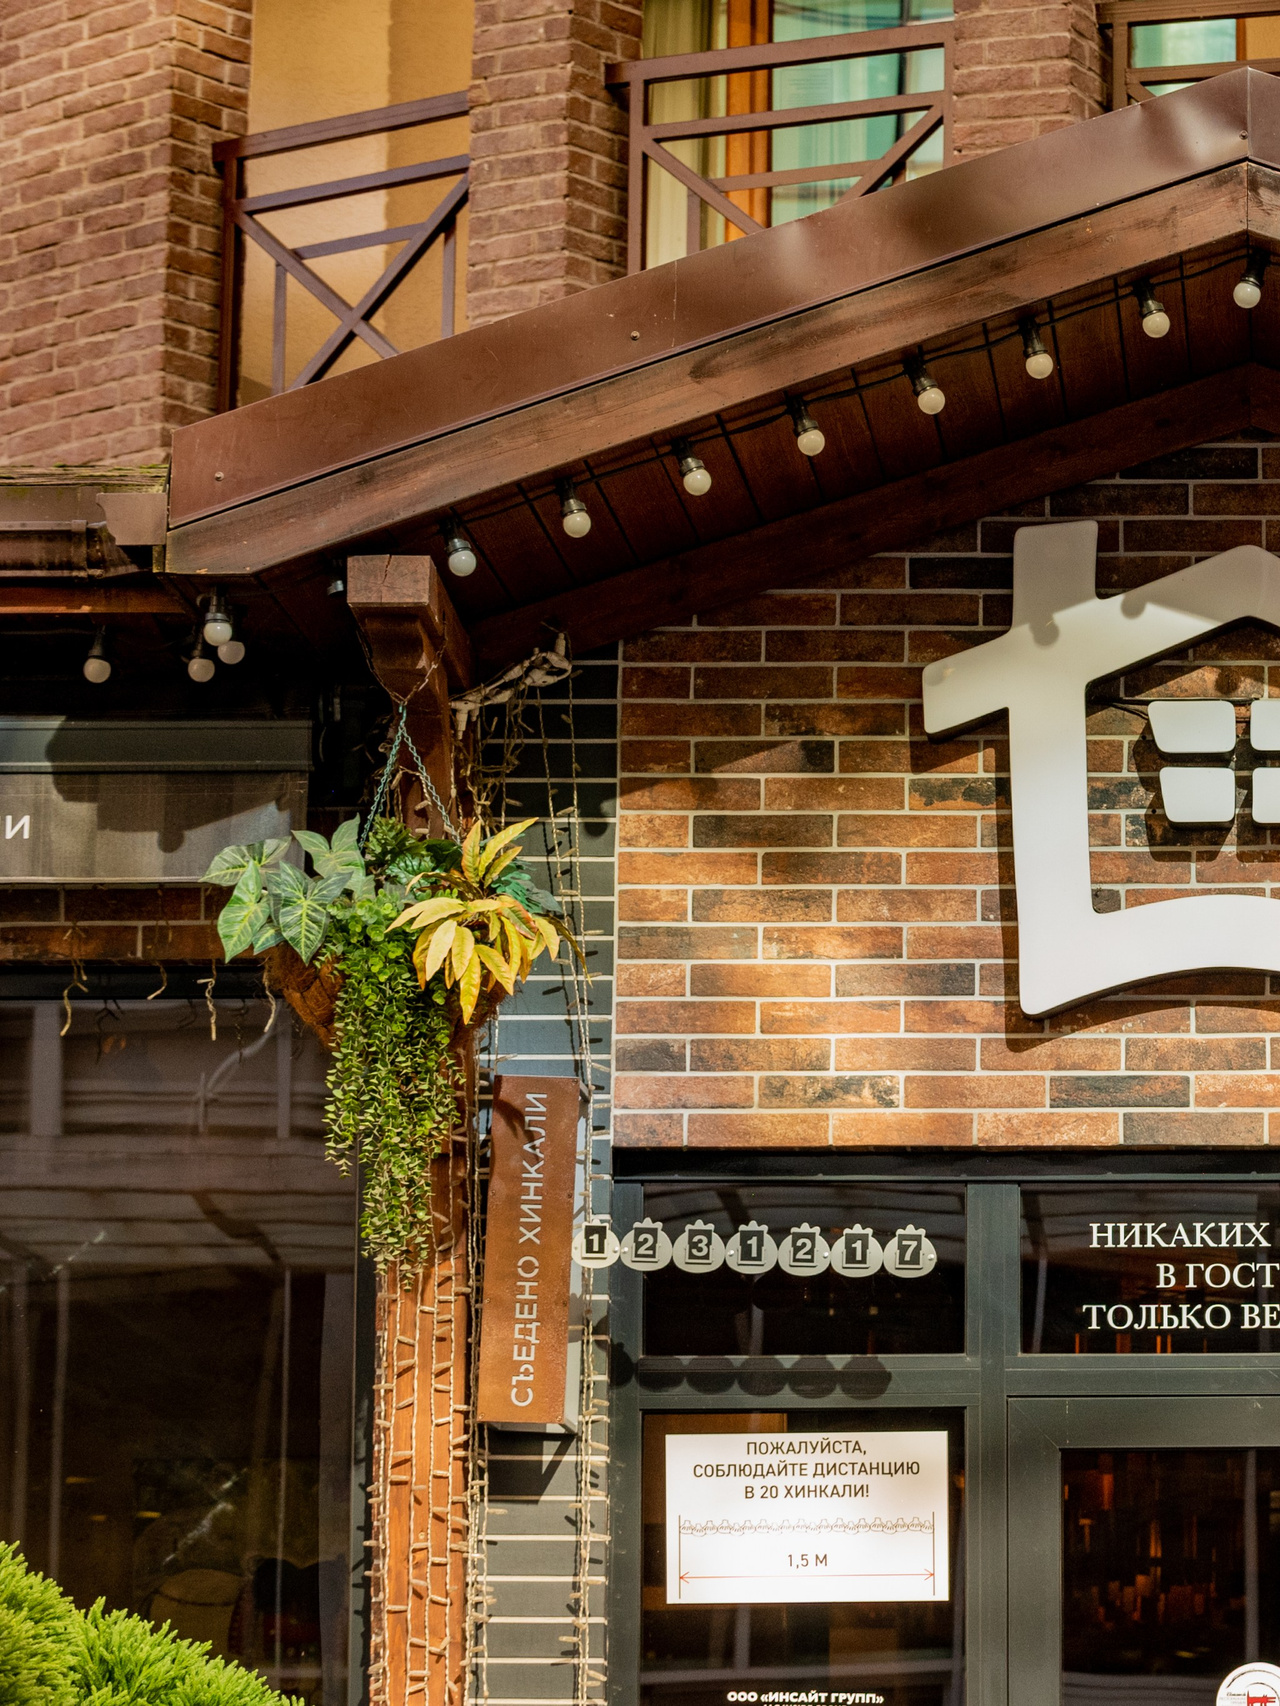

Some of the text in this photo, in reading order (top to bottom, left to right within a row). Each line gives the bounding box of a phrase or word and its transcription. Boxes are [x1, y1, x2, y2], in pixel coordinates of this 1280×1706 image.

[1089, 1222, 1271, 1248] НИКАКИХ
[511, 1093, 548, 1407] СЪЕДЕНО ХИНКАЛИ
[1156, 1263, 1176, 1288] В
[1083, 1304, 1231, 1330] ТОЛЬКО
[746, 1437, 867, 1456] ПОЖАЛУЙСТА,
[693, 1460, 920, 1479] СОБЛЮДАЙТЕ ДИСТАНЦИЮ
[744, 1484, 870, 1499] В 20 ХИНКАЛИ!
[787, 1554, 828, 1568] 1,5 М
[727, 1690, 884, 1704] ООО «ИНСАЙТ ГРУПП»
